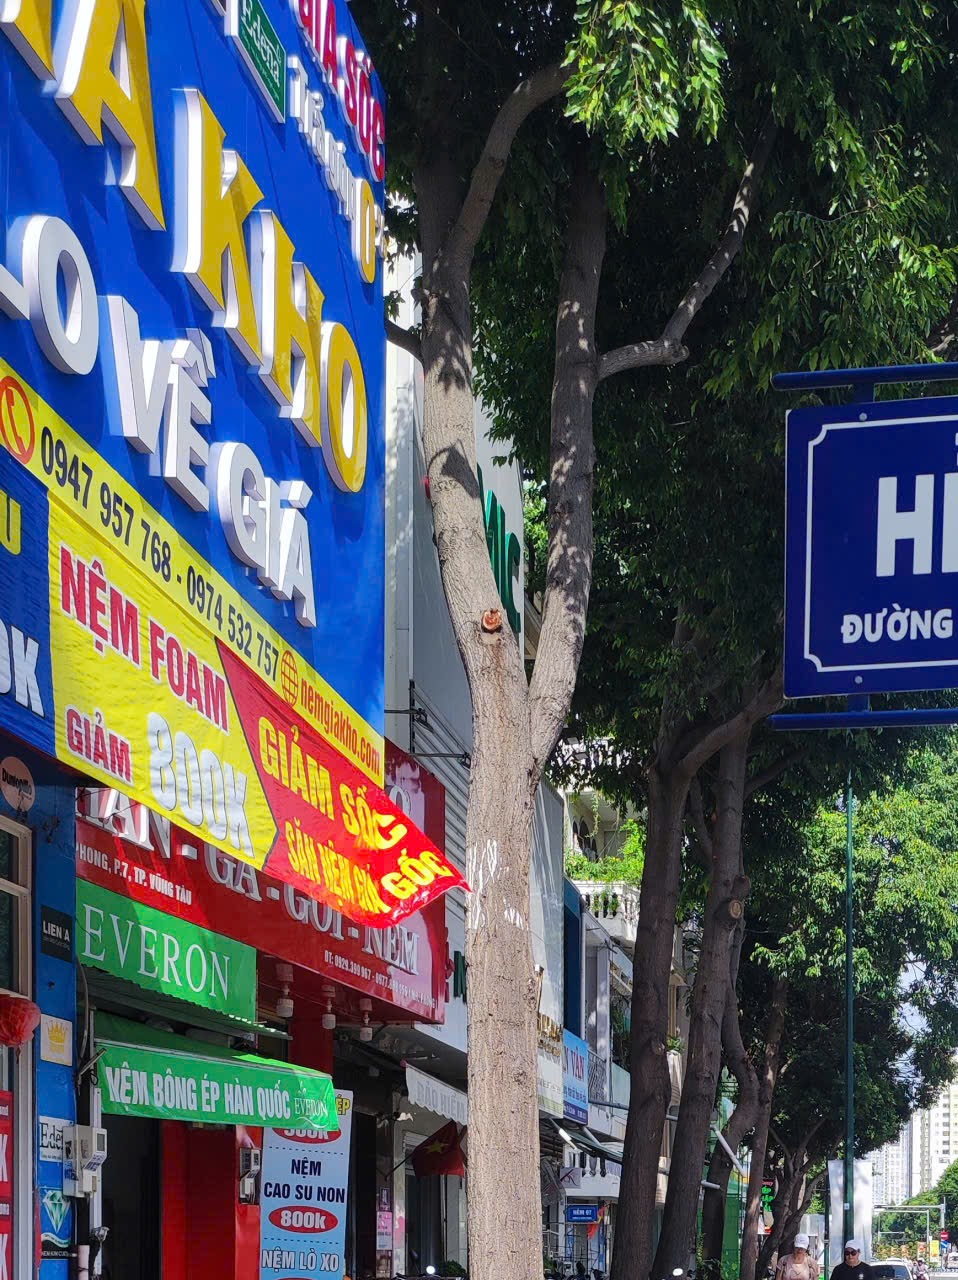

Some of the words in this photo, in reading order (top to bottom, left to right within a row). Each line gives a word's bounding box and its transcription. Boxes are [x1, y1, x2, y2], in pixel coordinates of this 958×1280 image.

[99, 294, 216, 513] VỀ
[211, 440, 317, 628] GIÁ
[41, 427, 93, 510] 0947
[99, 481, 134, 547] 957
[140, 518, 171, 584] 768
[187, 570, 223, 630] 0974
[227, 607, 252, 657] 532
[256, 630, 280, 683] 757
[300, 676, 382, 779] nemgiakho.com
[841, 602, 954, 645] ĐƯỜNG
[60, 543, 141, 667] NỆM
[150, 620, 230, 734] FOAM
[66, 704, 132, 785] GIẢM
[146, 710, 256, 860] 800K
[258, 715, 337, 821] GIẢM
[340, 782, 407, 850] SỐC
[285, 815, 321, 885] SĂN
[318, 840, 355, 907] NỆM
[381, 848, 454, 900] GỐC
[175, 884, 192, 905] TÀU
[81, 903, 232, 1002] EVERON
[153, 1067, 197, 1112] BÔNG
[201, 1072, 220, 1114] ÉP
[224, 1077, 254, 1116] HÀN
[256, 1079, 291, 1121] QUỐC
[295, 1096, 329, 1119] EVERON
[39, 1121, 63, 1150] Ede
[263, 1182, 291, 1199] CAO
[294, 1184, 313, 1201] SU
[316, 1186, 345, 1203] NON
[290, 1156, 322, 1177] NỆM
[280, 1210, 326, 1229] 800k
[261, 1249, 296, 1277] NỆM
[298, 1247, 317, 1272] LÒ
[320, 1253, 339, 1272] XO
